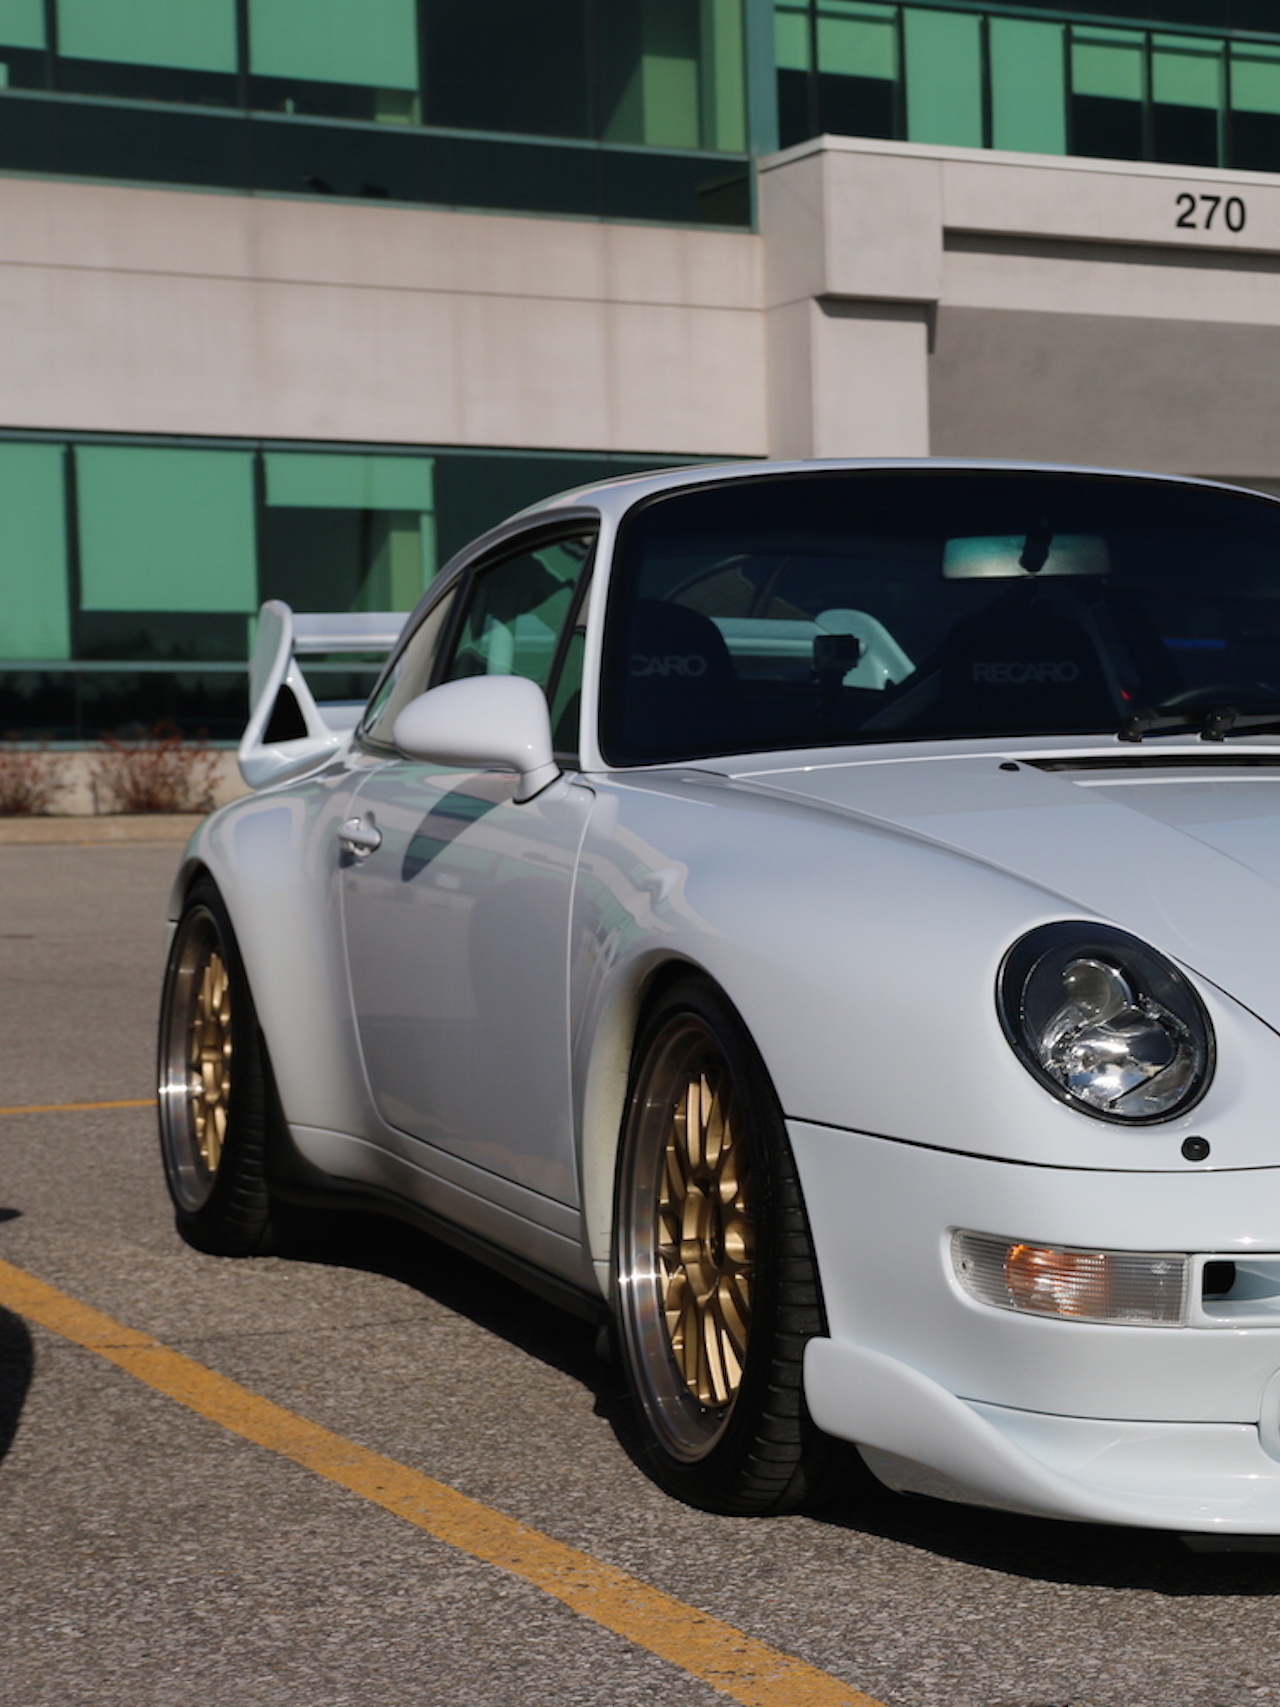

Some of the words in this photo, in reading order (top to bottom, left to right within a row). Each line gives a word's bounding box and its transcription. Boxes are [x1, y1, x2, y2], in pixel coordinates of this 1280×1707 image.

[1176, 192, 1246, 232] 270
[630, 653, 707, 677] CARO
[972, 660, 1079, 683] RECARO
